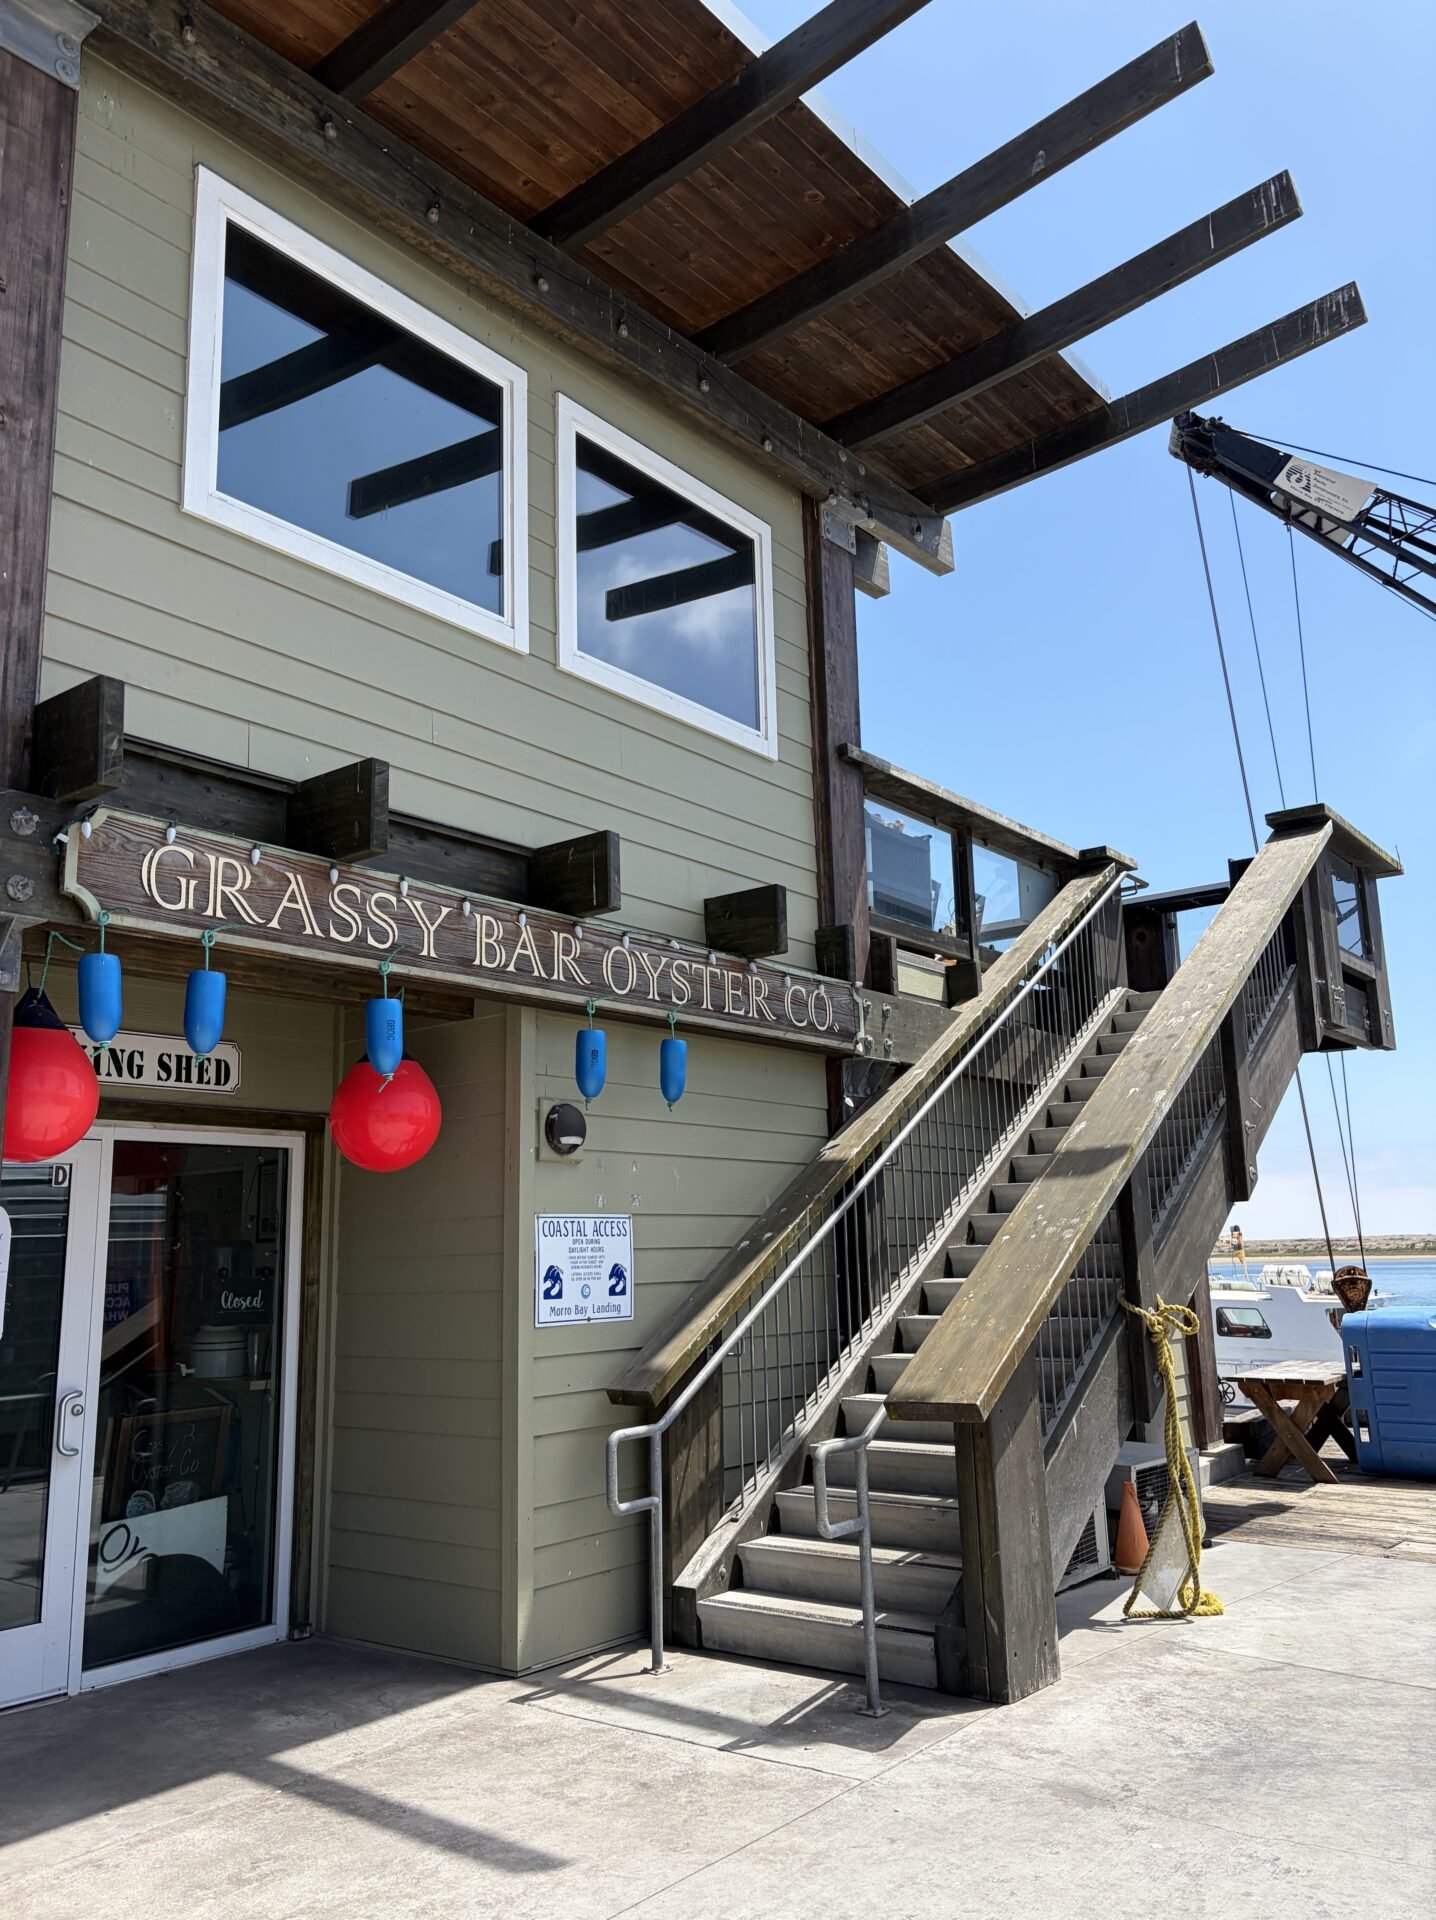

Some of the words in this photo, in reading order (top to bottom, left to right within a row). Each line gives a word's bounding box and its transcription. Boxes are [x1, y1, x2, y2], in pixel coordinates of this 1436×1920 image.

[142, 845, 452, 958] GRASSY
[472, 912, 592, 986] BAR
[603, 945, 777, 1021] OYSTER
[784, 985, 840, 1033] CO.
[80, 1044, 144, 1080] ING
[156, 1052, 231, 1087] SHED
[54, 1165, 67, 1186] D
[542, 1220, 588, 1238] COASTAL
[592, 1220, 628, 1237] ACCESS
[221, 1289, 264, 1310] Closed
[549, 1305, 572, 1317] Morro
[574, 1304, 588, 1317] Bay
[592, 1302, 622, 1315] Landing
